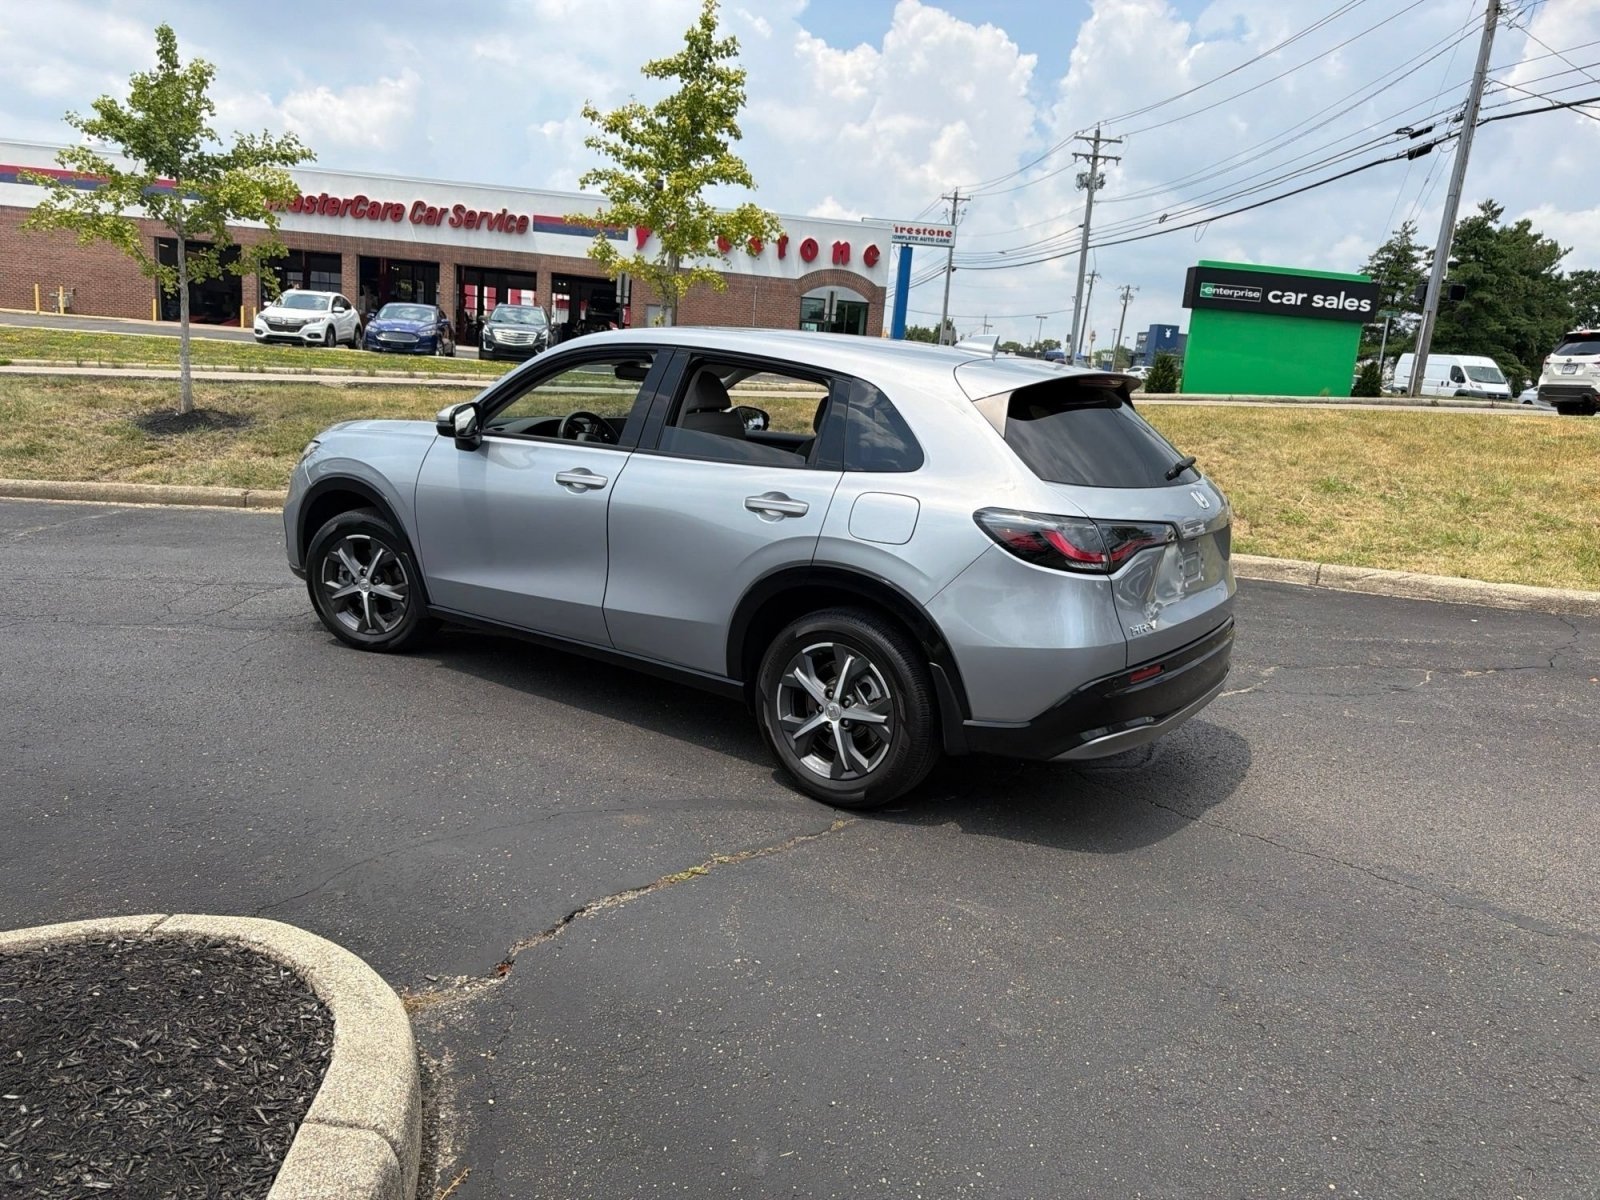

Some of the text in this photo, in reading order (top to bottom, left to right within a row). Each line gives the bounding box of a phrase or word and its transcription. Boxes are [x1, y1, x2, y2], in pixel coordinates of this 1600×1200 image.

[409, 200, 449, 226] Car
[448, 204, 530, 235] Service
[892, 234, 919, 242] OMPLETE
[919, 235, 935, 243] AUTO
[893, 224, 953, 238] irestone
[1204, 286, 1372, 312] enterprise car sales
